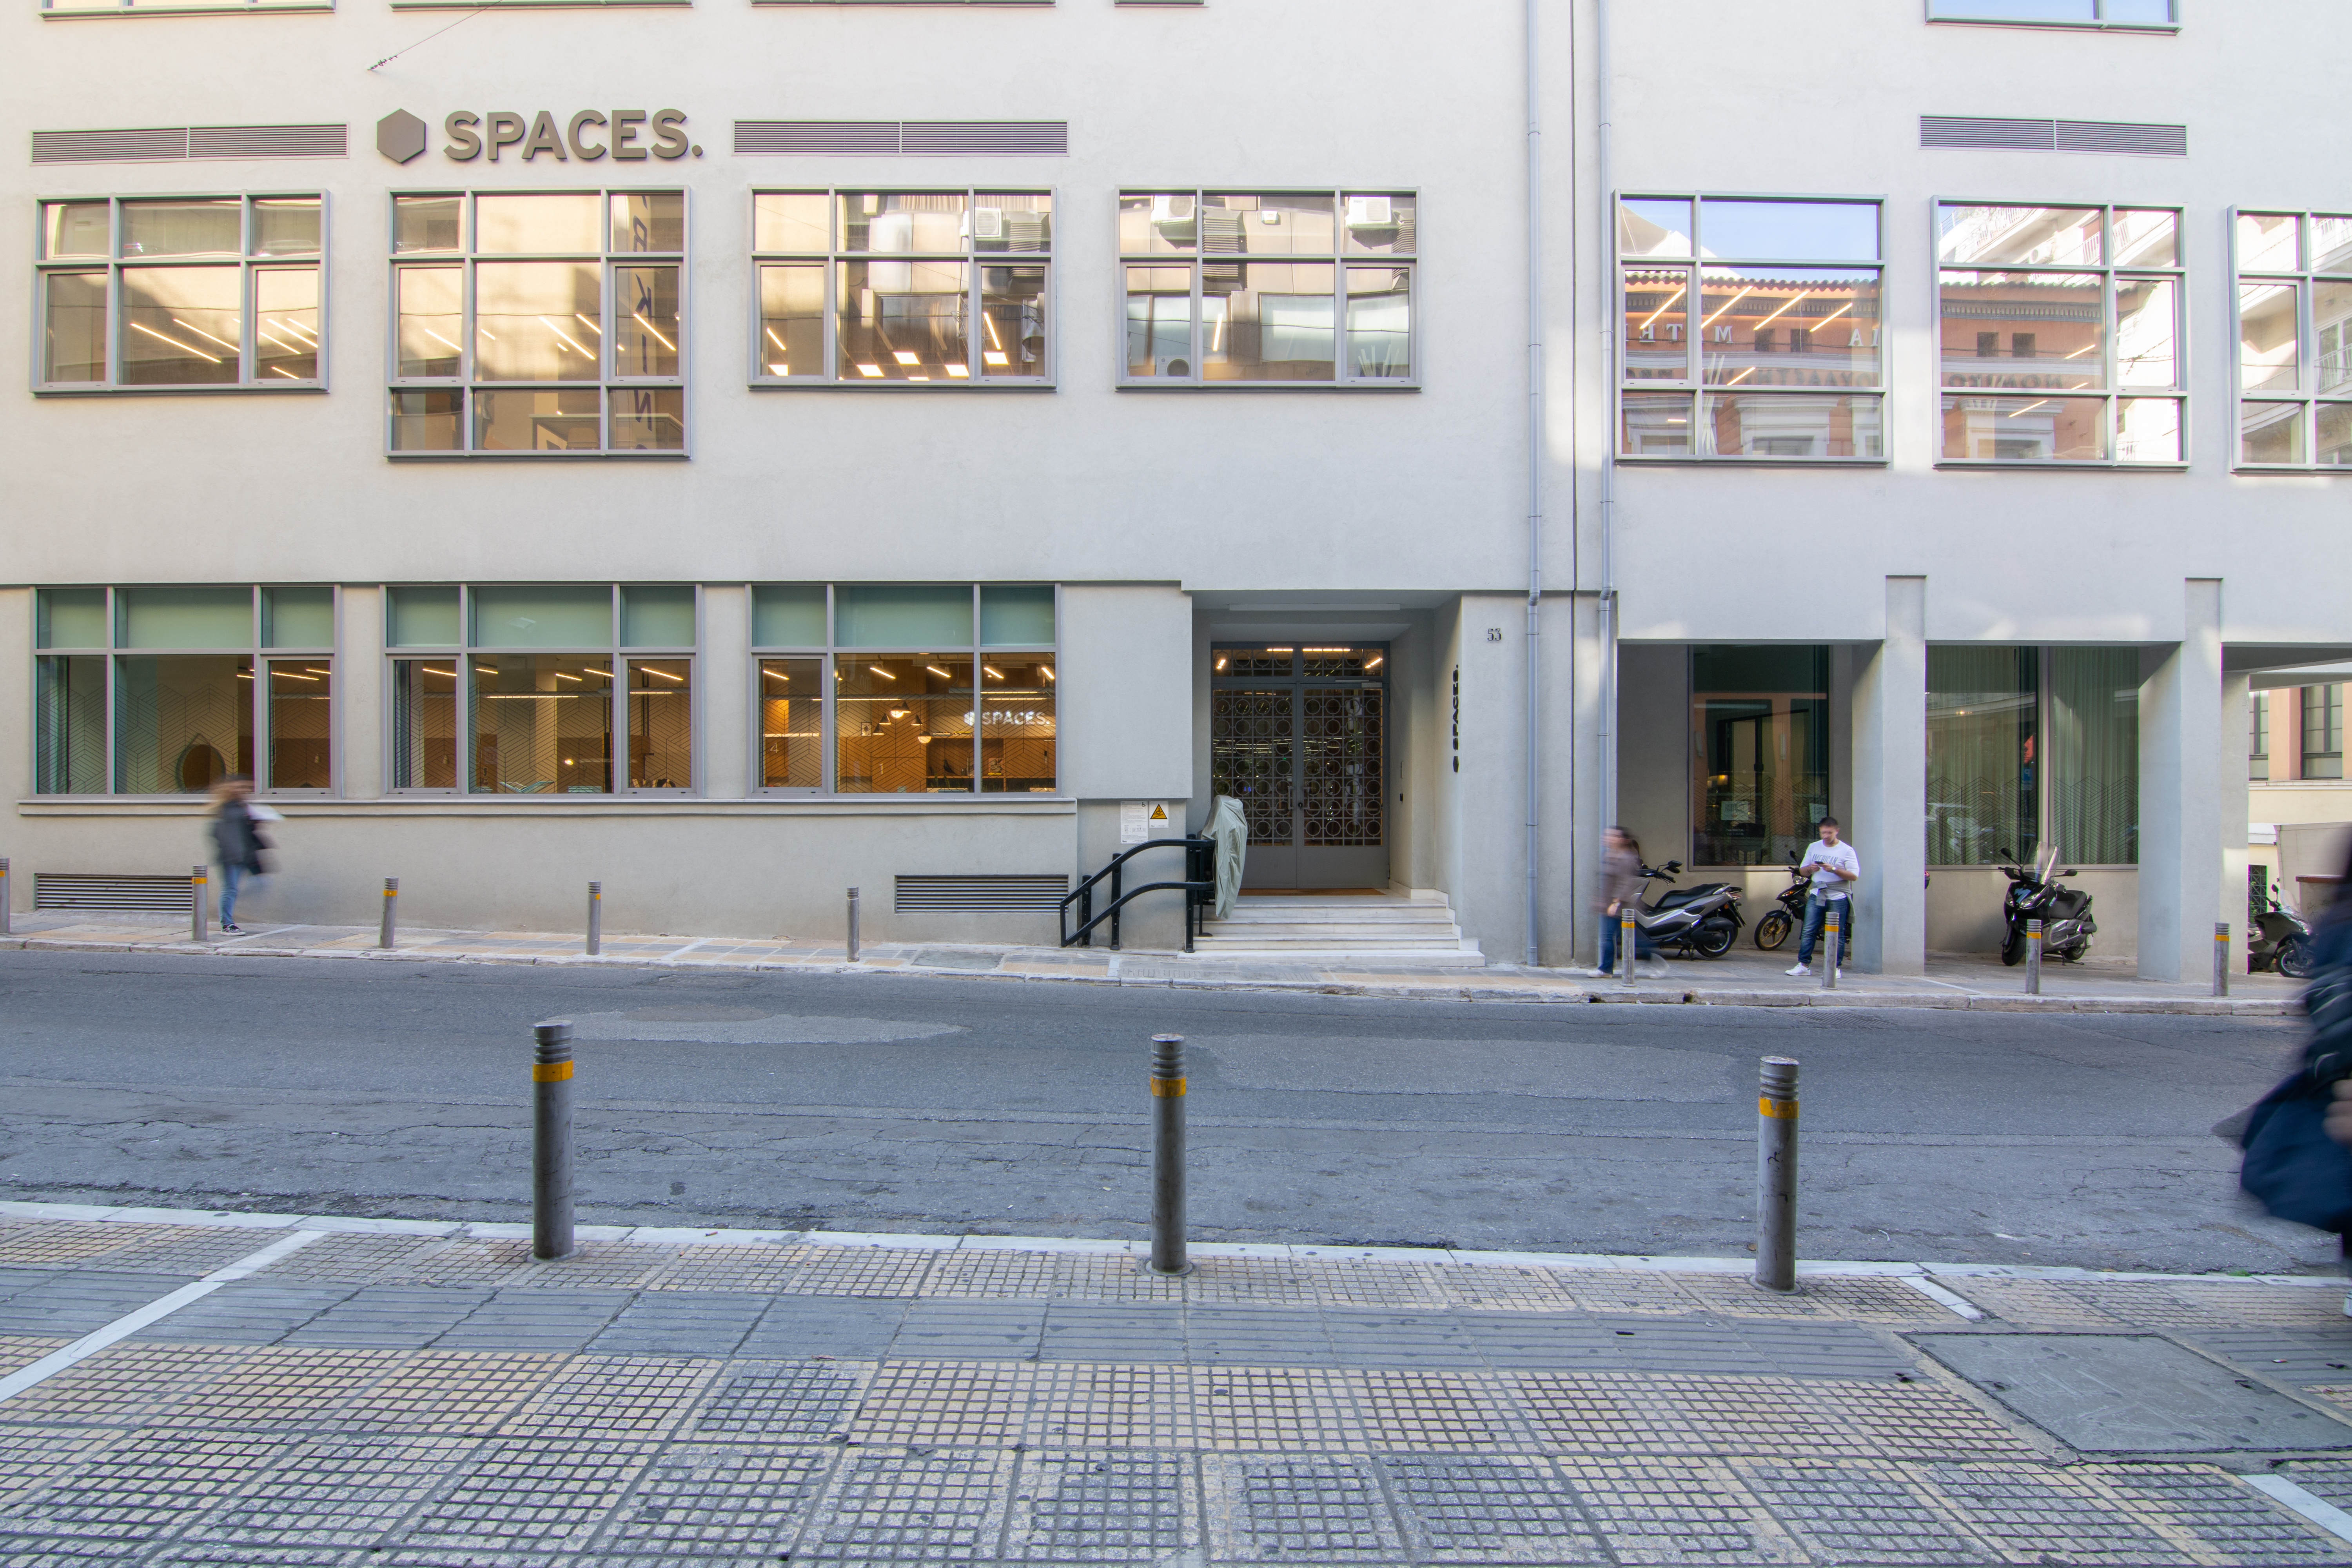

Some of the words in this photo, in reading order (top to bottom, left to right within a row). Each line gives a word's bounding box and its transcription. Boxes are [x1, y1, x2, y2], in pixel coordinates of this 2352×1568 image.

[443, 108, 703, 161] SPACES.
[1487, 628, 1502, 641] 53
[982, 711, 1050, 725] SPACES.
[770, 742, 779, 753] 4
